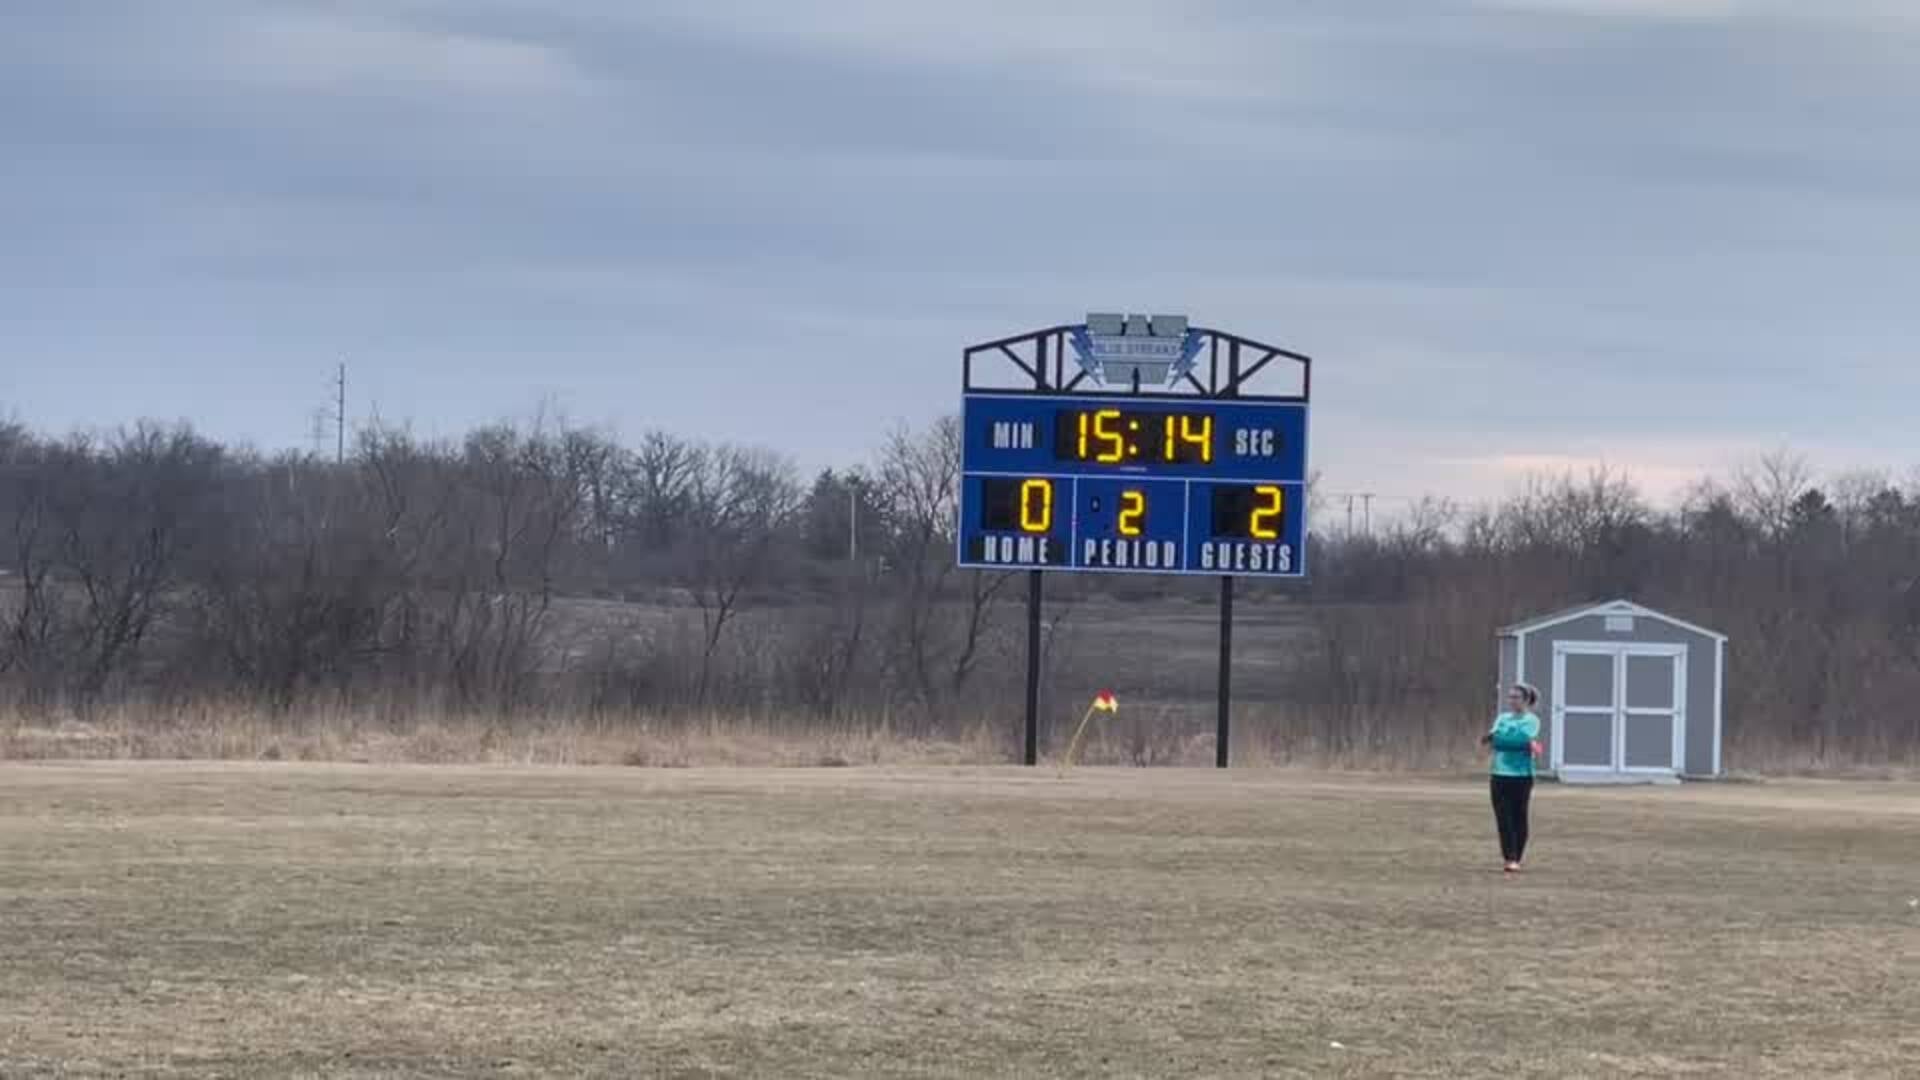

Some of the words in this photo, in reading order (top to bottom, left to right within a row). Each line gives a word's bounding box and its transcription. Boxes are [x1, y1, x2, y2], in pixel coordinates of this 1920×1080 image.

[994, 421, 1033, 449] MIN
[1079, 409, 1211, 462] 15:14
[1235, 428, 1274, 456] SEC
[1021, 479, 1051, 532] 0
[1119, 491, 1143, 535] 2
[1251, 486, 1281, 539] 2
[984, 535, 1049, 563] HOME
[1084, 538, 1175, 568] PERIOD
[1201, 541, 1291, 571] GUESTS
